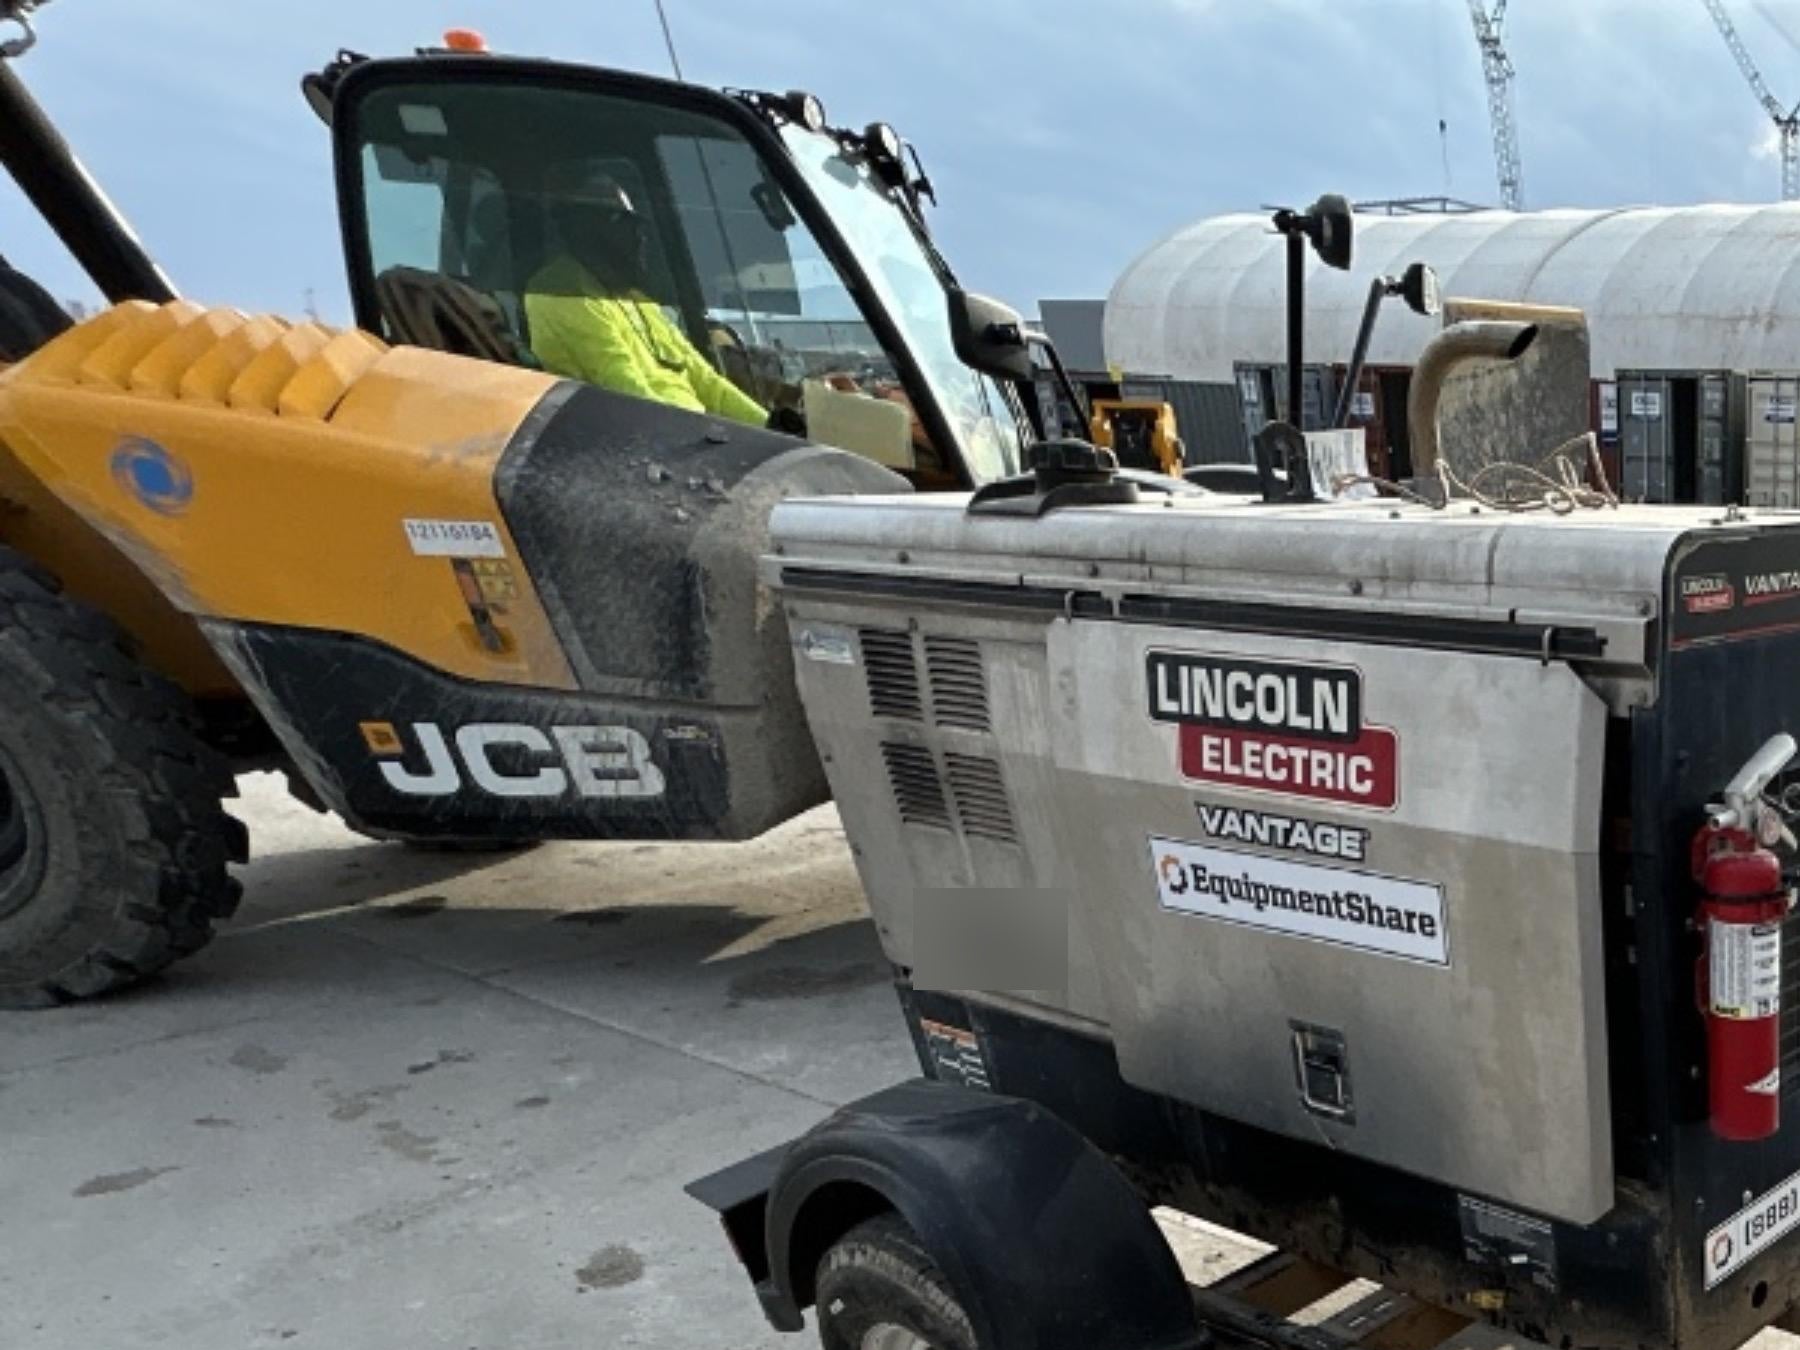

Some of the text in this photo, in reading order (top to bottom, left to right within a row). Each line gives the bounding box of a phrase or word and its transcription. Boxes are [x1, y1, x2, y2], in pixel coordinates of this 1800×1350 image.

[1156, 662, 1349, 733] LINCOLN
[377, 722, 666, 796] JCB
[1201, 734, 1374, 795] ELECTRIC
[1197, 803, 1364, 861] VANTAGE
[1189, 862, 1439, 938] EquipmentShare
